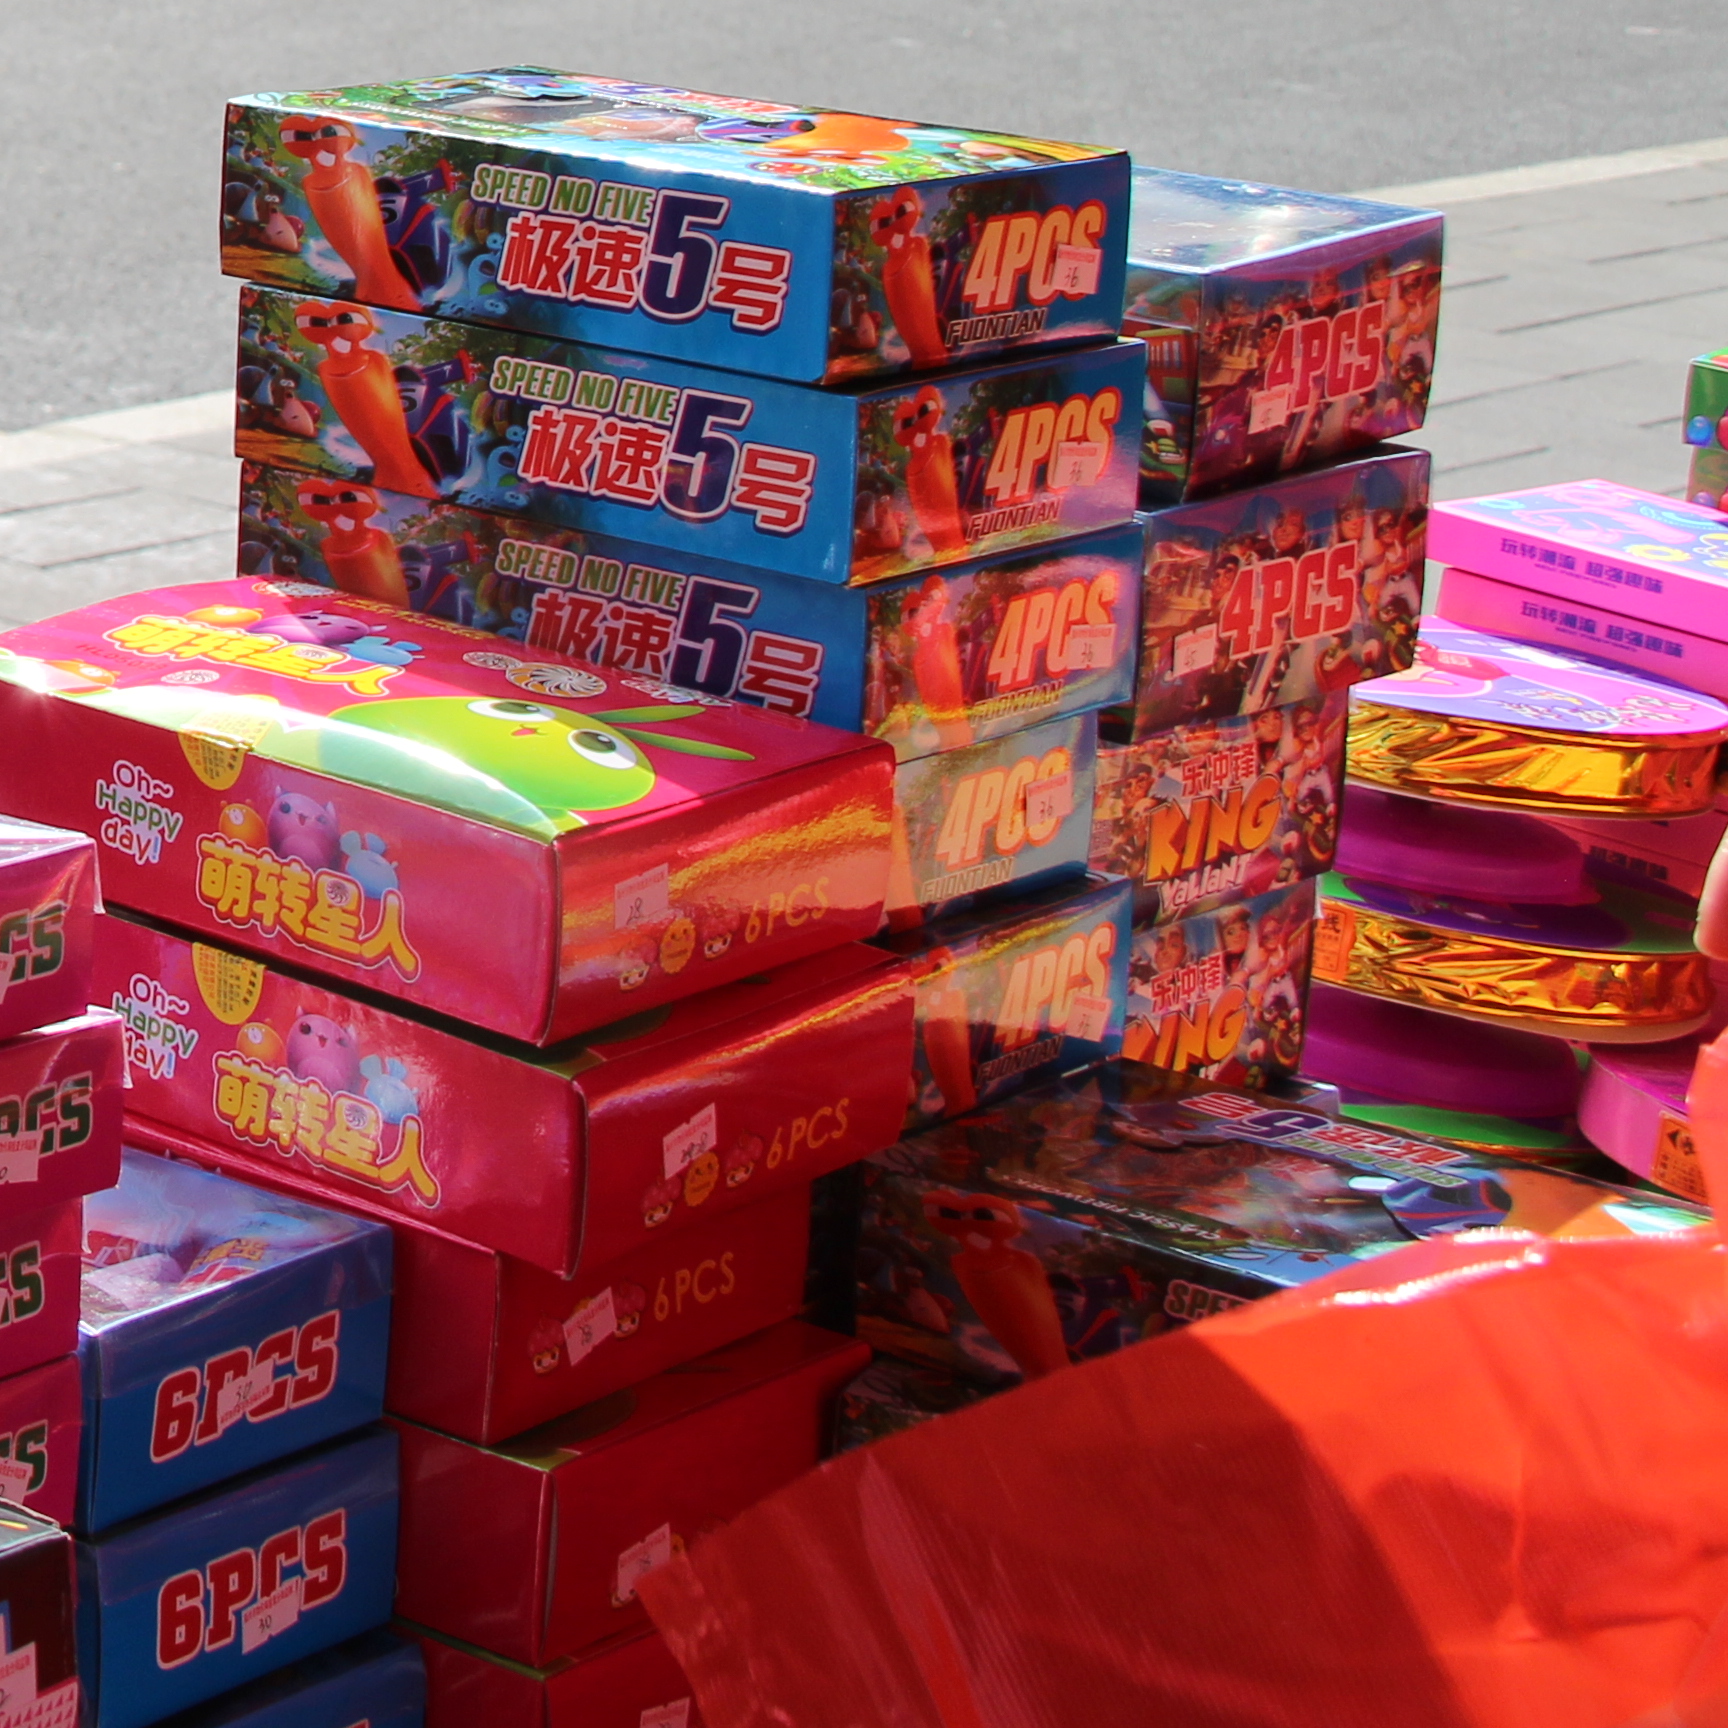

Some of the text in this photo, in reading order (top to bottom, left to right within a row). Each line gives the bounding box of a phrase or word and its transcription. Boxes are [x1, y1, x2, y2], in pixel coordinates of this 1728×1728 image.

[471, 164, 655, 226] SPEED NO FIVE
[497, 188, 793, 332] 极速5号
[962, 200, 1107, 314] 4PCS
[489, 355, 679, 424] SPEED NO FIVE
[1265, 299, 1386, 412] 4PCS
[517, 388, 817, 534] 极速5号
[984, 386, 1122, 508] 4PCS
[495, 539, 685, 611] SPEED NO FIVE
[1220, 539, 1360, 661] 4PCS
[1500, 537, 1578, 573] 玩转潮流
[1585, 560, 1665, 595] 超强趣味
[102, 613, 407, 698] 萌转星人
[524, 574, 825, 718] 极速5号
[987, 570, 1122, 693] 4PCS
[1521, 600, 1598, 636] 玩转潮流
[1605, 623, 1686, 660] 超强趣味
[95, 781, 184, 845] Happy
[934, 746, 1073, 874] 4PCS
[1180, 741, 1258, 799] 乐冲锋
[98, 819, 162, 866] day!
[1146, 773, 1284, 886] KING
[196, 832, 423, 983] 萌转星人
[111, 991, 199, 1059] Happy
[997, 920, 1118, 1053] 4PCS
[1123, 983, 1247, 1072] KING
[1149, 953, 1224, 1014] 乐冲锋
[211, 1049, 442, 1209] 萌转星人
[150, 1308, 342, 1465] 6PCS
[156, 1507, 347, 1672] 6PCS
